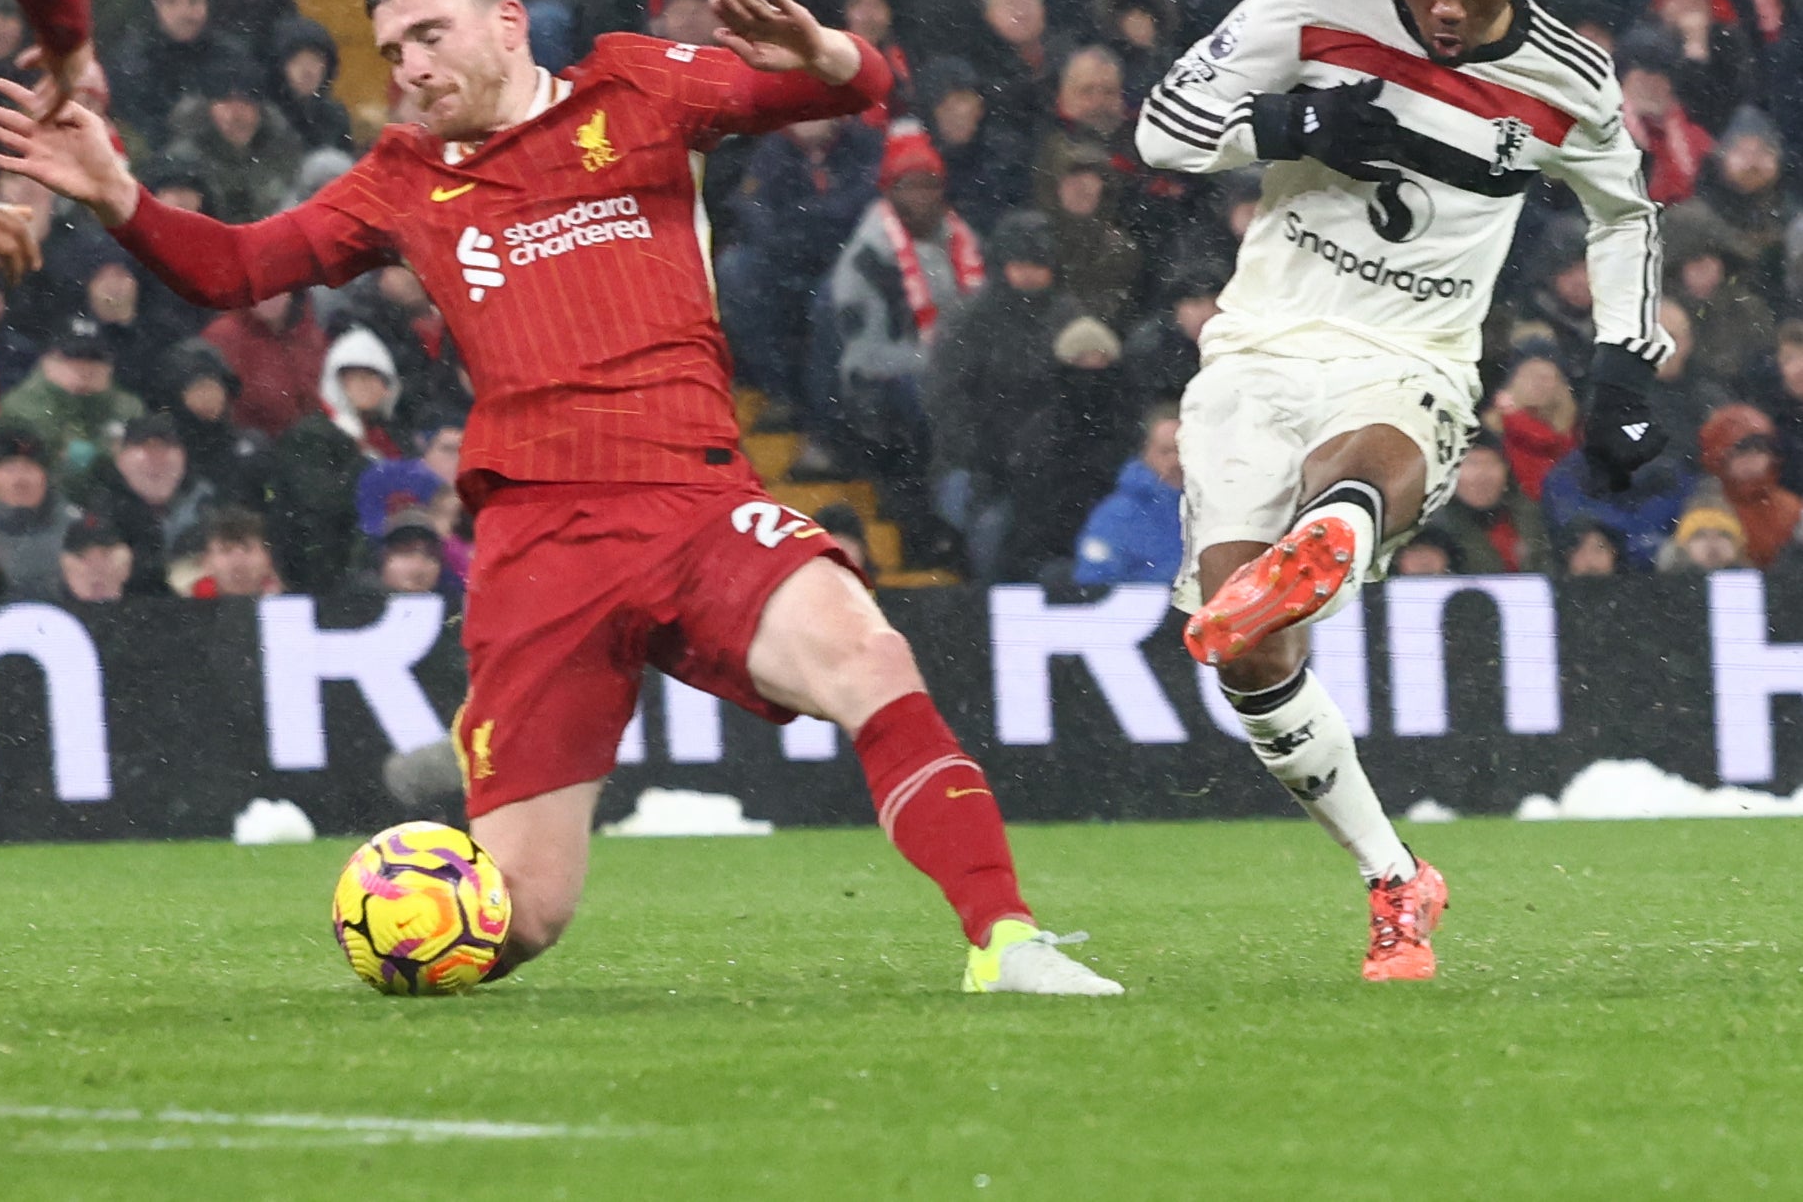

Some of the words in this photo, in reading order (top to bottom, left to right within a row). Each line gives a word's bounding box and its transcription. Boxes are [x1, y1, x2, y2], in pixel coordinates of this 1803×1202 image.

[503, 194, 639, 246] standard
[509, 216, 653, 265] chartered
[1285, 210, 1474, 303] Snapdragon
[731, 501, 813, 548] 2
